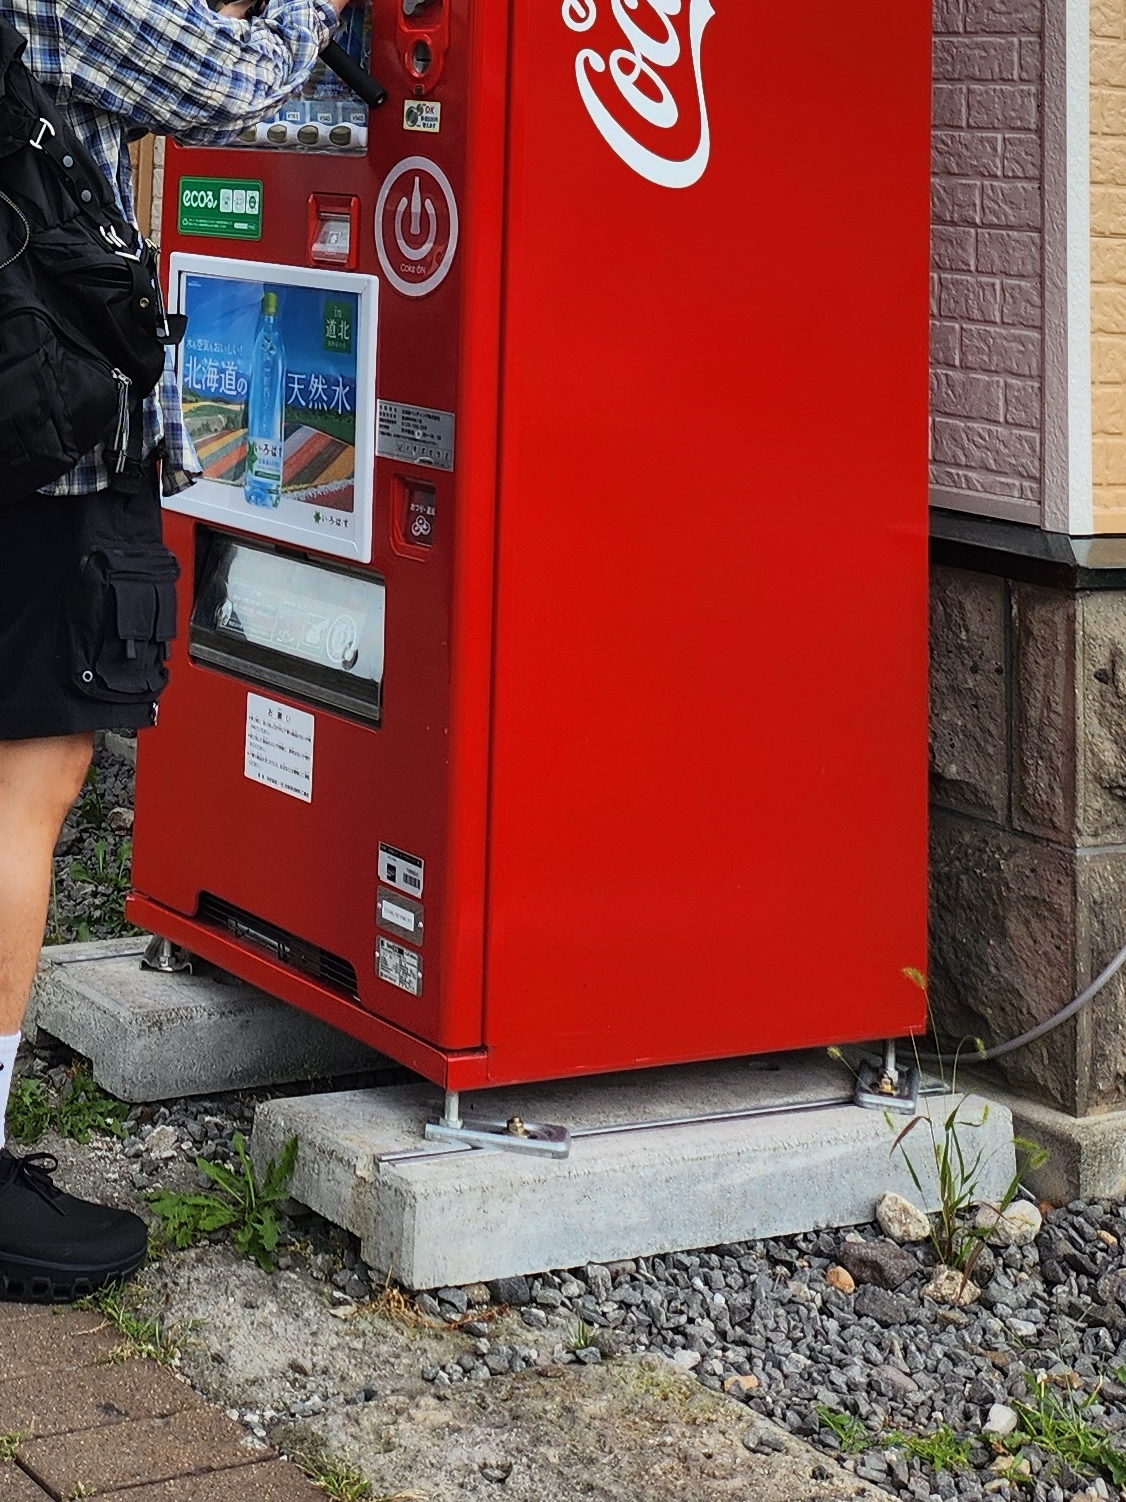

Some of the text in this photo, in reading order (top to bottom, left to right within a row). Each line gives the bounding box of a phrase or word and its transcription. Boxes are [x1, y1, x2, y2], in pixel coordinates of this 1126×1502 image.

[334, 306, 342, 318] in
[326, 319, 350, 340] 道北
[184, 355, 248, 396] 北海道の
[287, 372, 352, 416] 天然水
